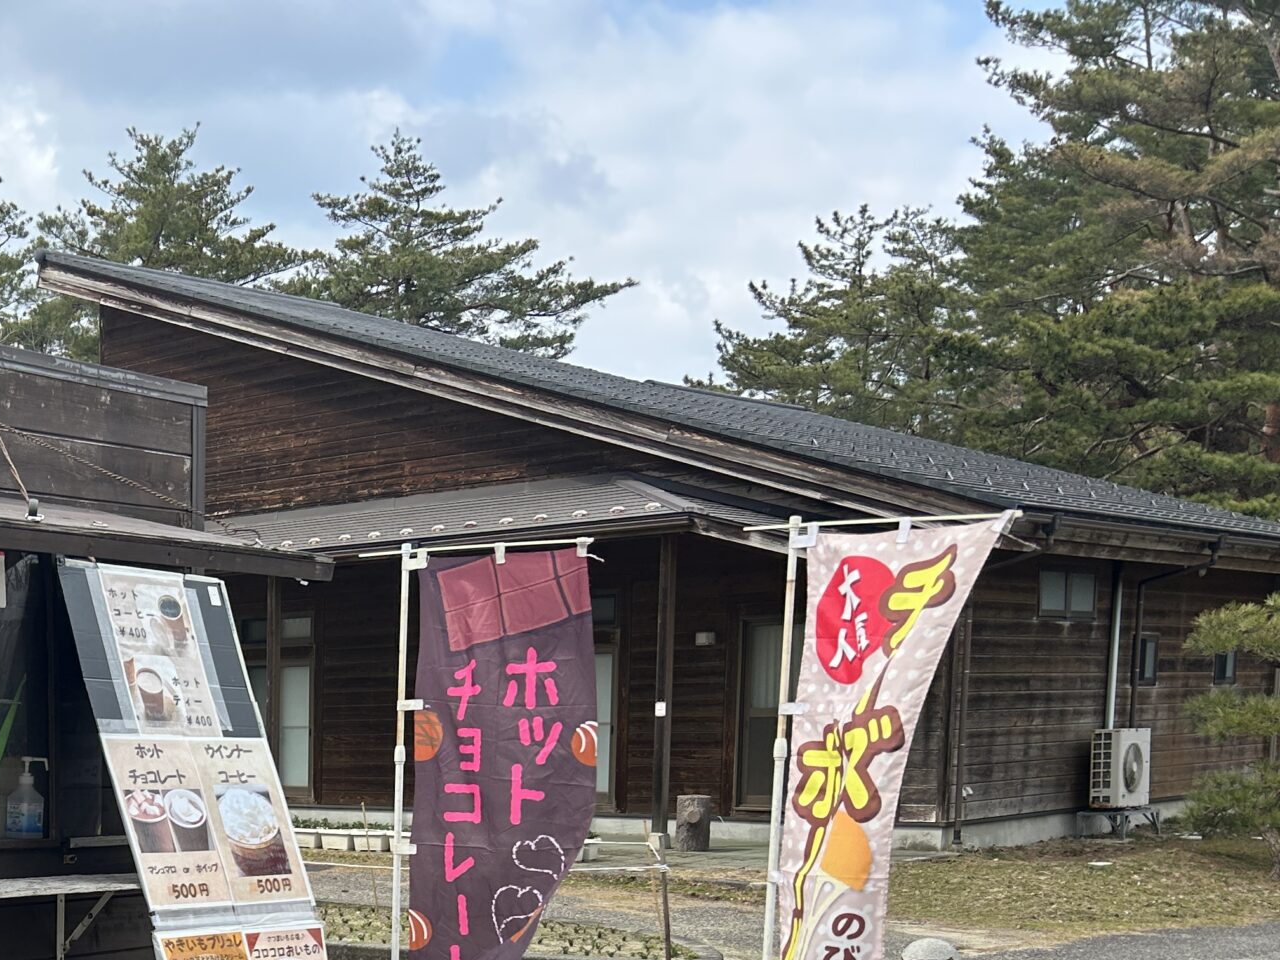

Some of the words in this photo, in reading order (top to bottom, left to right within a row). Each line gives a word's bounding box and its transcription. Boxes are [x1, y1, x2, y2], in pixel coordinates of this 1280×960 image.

[107, 587, 138, 600] ホット
[113, 608, 156, 619] コーヒー
[172, 677, 201, 688] ホット
[173, 695, 202, 706] ティー
[504, 647, 563, 825] ホット
[135, 743, 163, 759] ホット
[128, 769, 186, 785] チョコレート
[218, 770, 256, 783] コーヒー
[253, 944, 320, 958] コロコロおいもの
